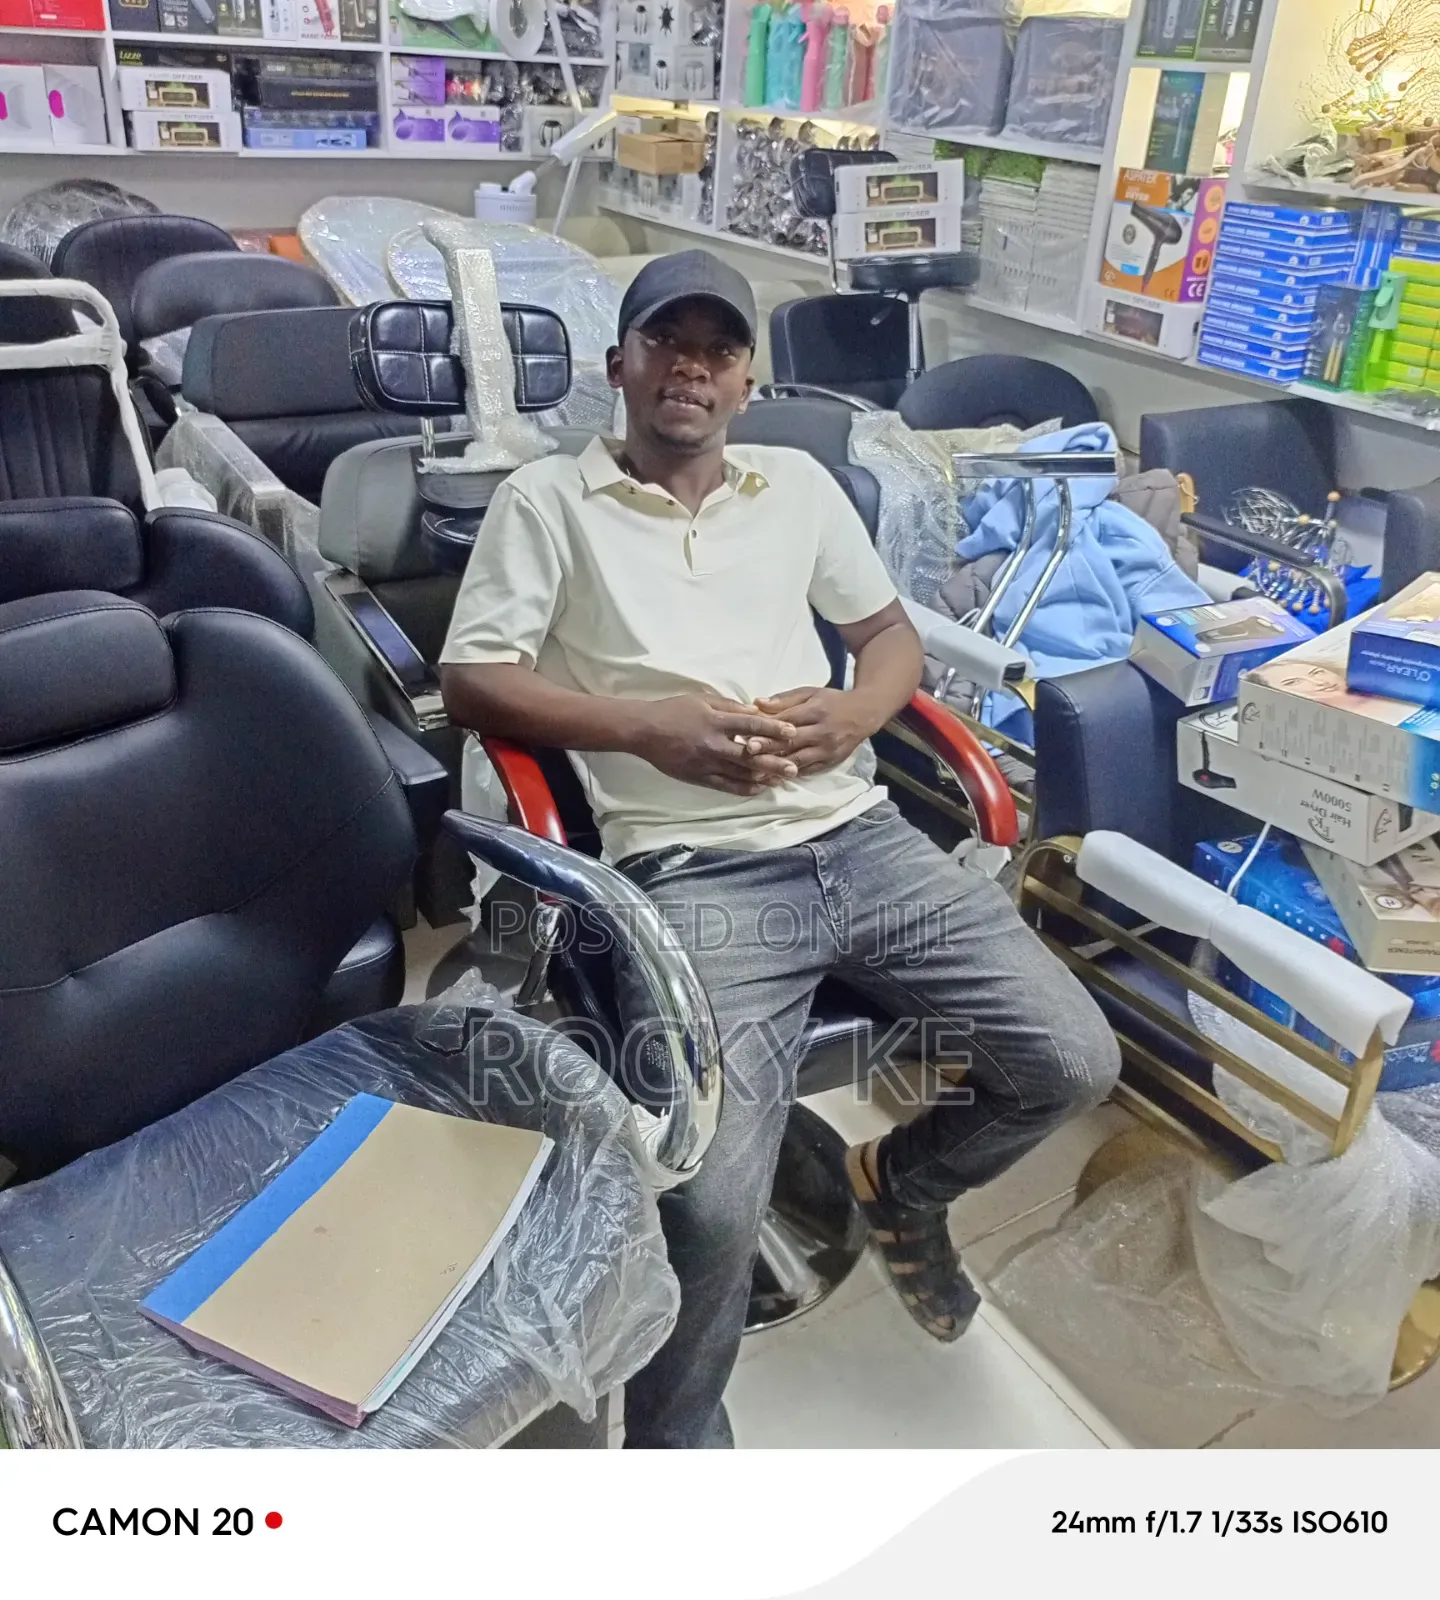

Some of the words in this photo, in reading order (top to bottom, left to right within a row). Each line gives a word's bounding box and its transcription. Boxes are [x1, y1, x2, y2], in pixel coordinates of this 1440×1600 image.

[1300, 799, 1327, 818] Dryer
[1311, 789, 1352, 812] 5000W
[1329, 812, 1352, 828] Hair
